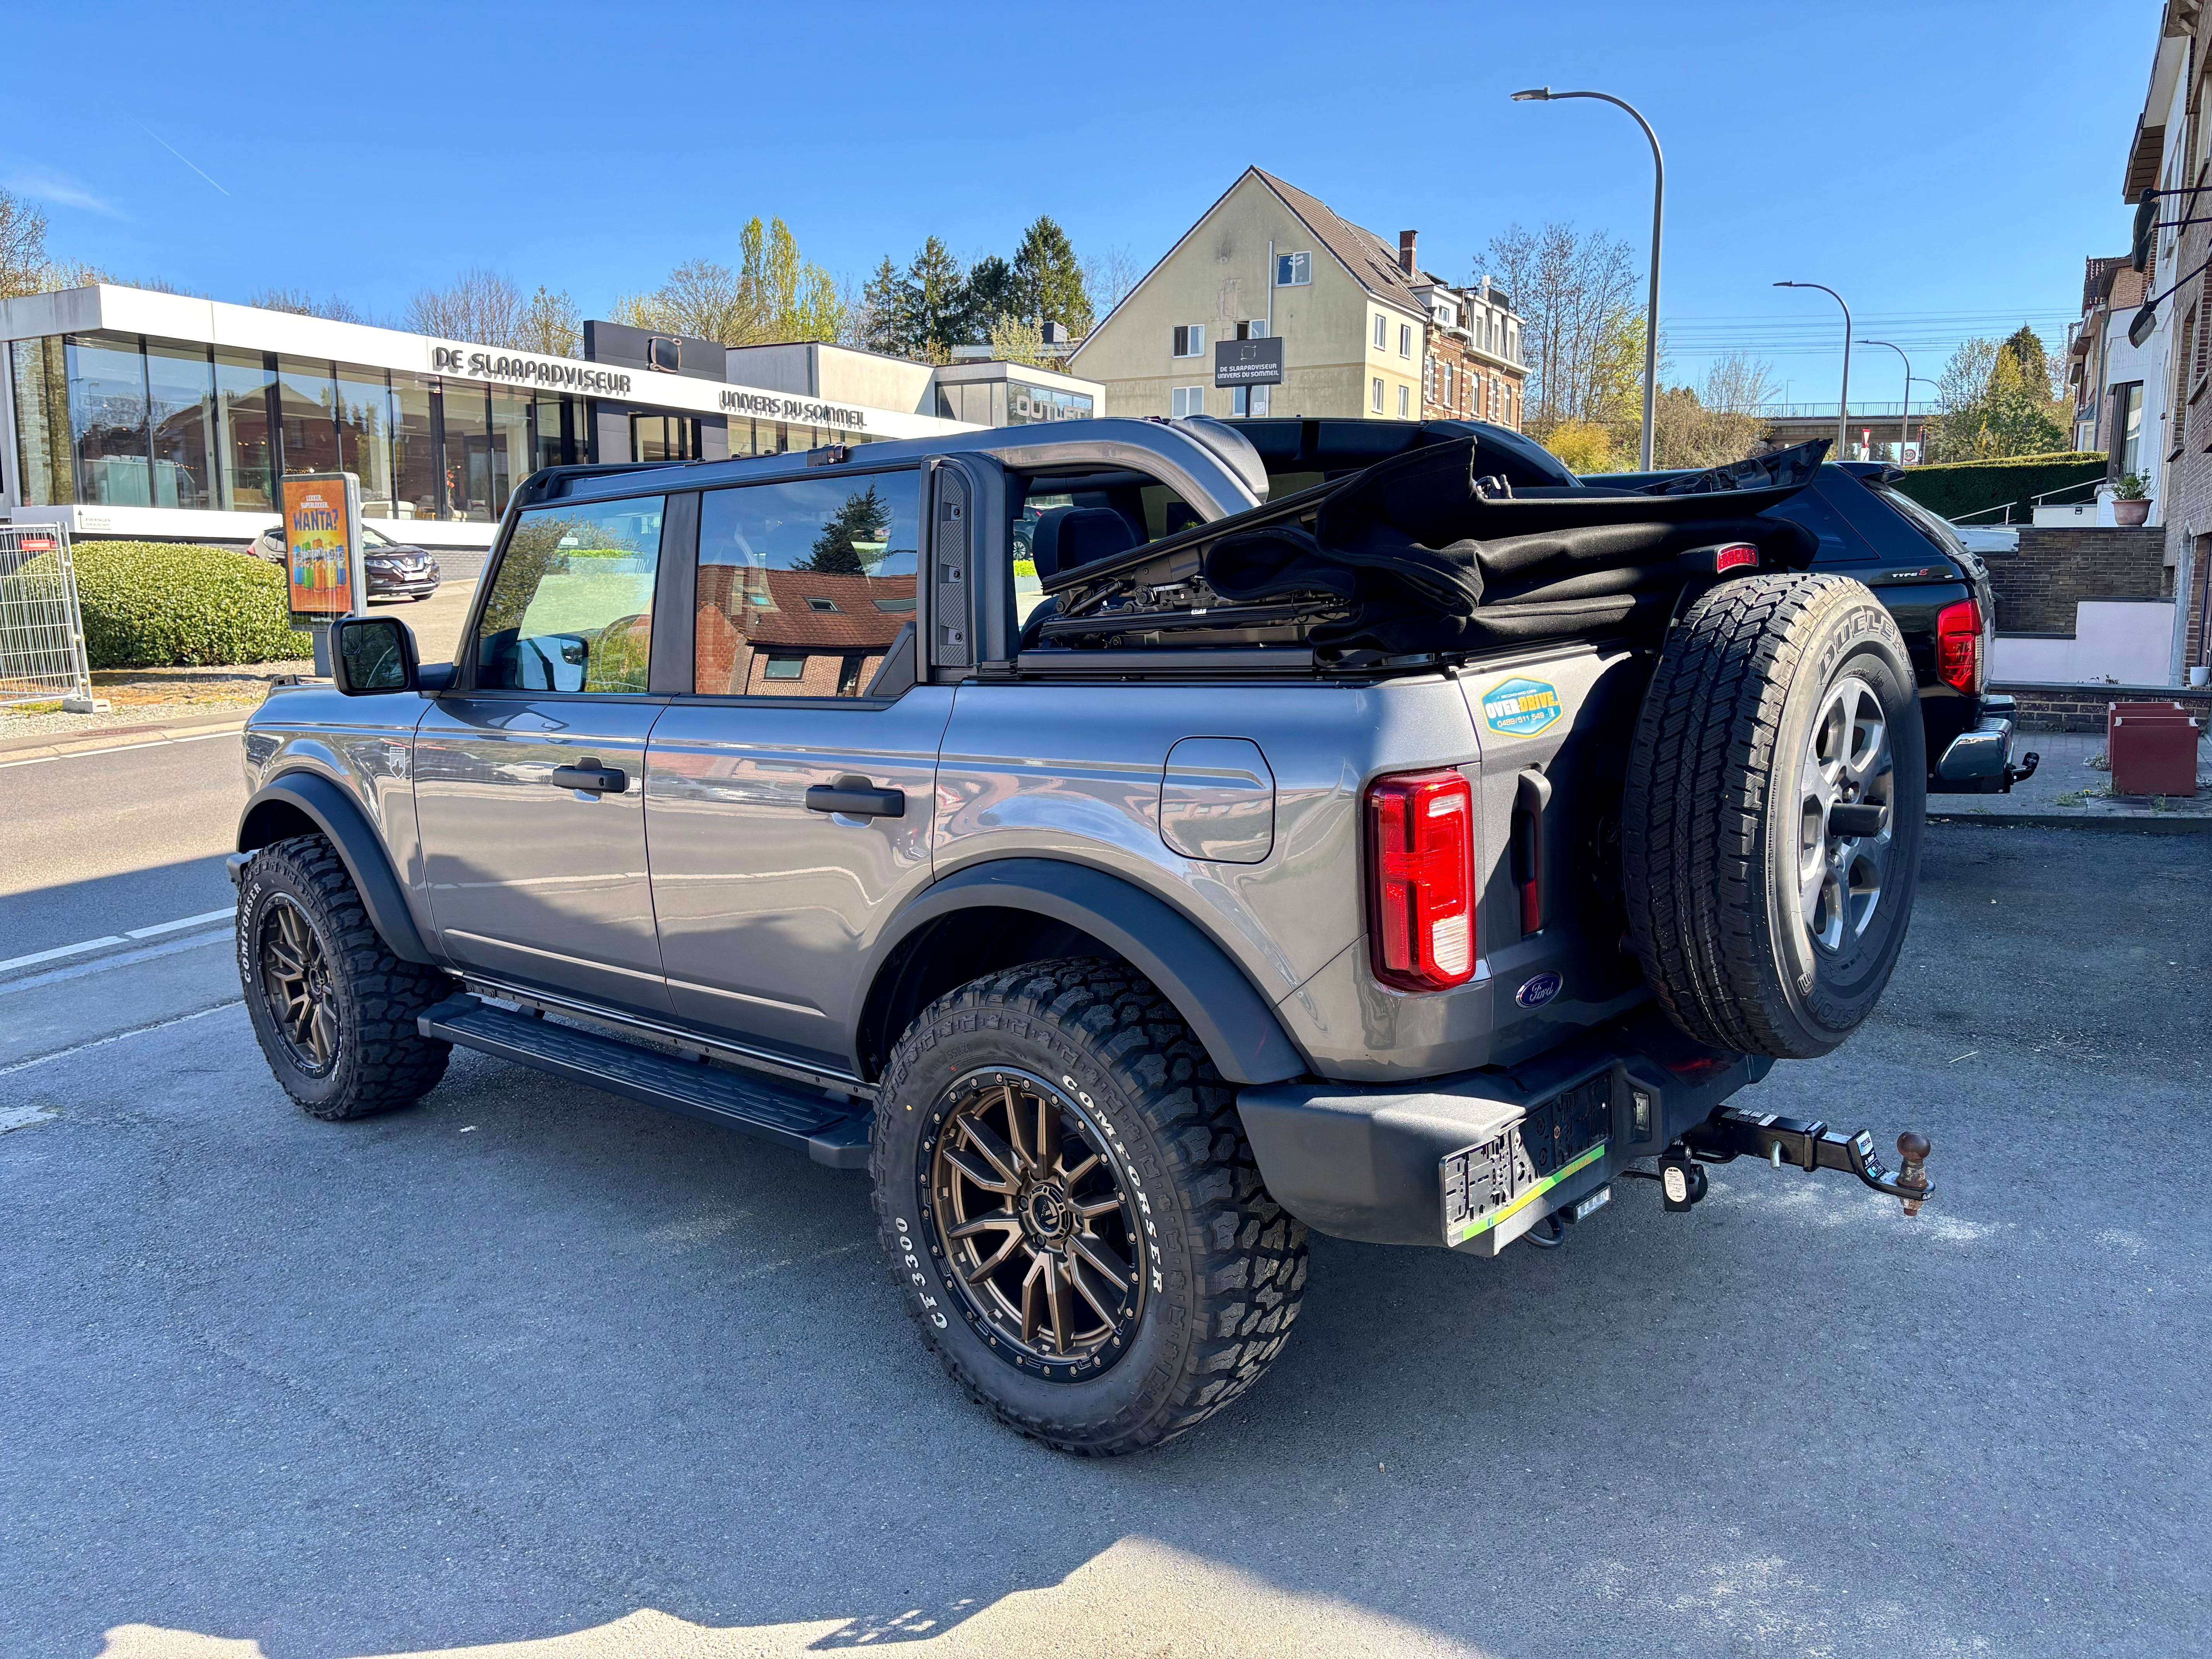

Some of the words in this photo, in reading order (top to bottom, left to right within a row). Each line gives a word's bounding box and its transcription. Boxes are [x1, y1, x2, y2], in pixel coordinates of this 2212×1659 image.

[435, 347, 464, 369] DE
[471, 353, 631, 392] SLAAPADVISEUR
[1229, 363, 1277, 371] SLAAPADVISEUR
[722, 390, 781, 413] UNIVERS
[785, 400, 802, 416] DU
[804, 404, 867, 426] SOMMEIL
[1017, 395, 1084, 421] OUTLET
[293, 508, 338, 531] WANTA?
[1817, 607, 1907, 686] DUELER
[242, 882, 262, 983] COMFORSER
[1529, 980, 1553, 1002] Ford
[1063, 1075, 1163, 1294] COMFORSER
[895, 1217, 948, 1329] CF3300
